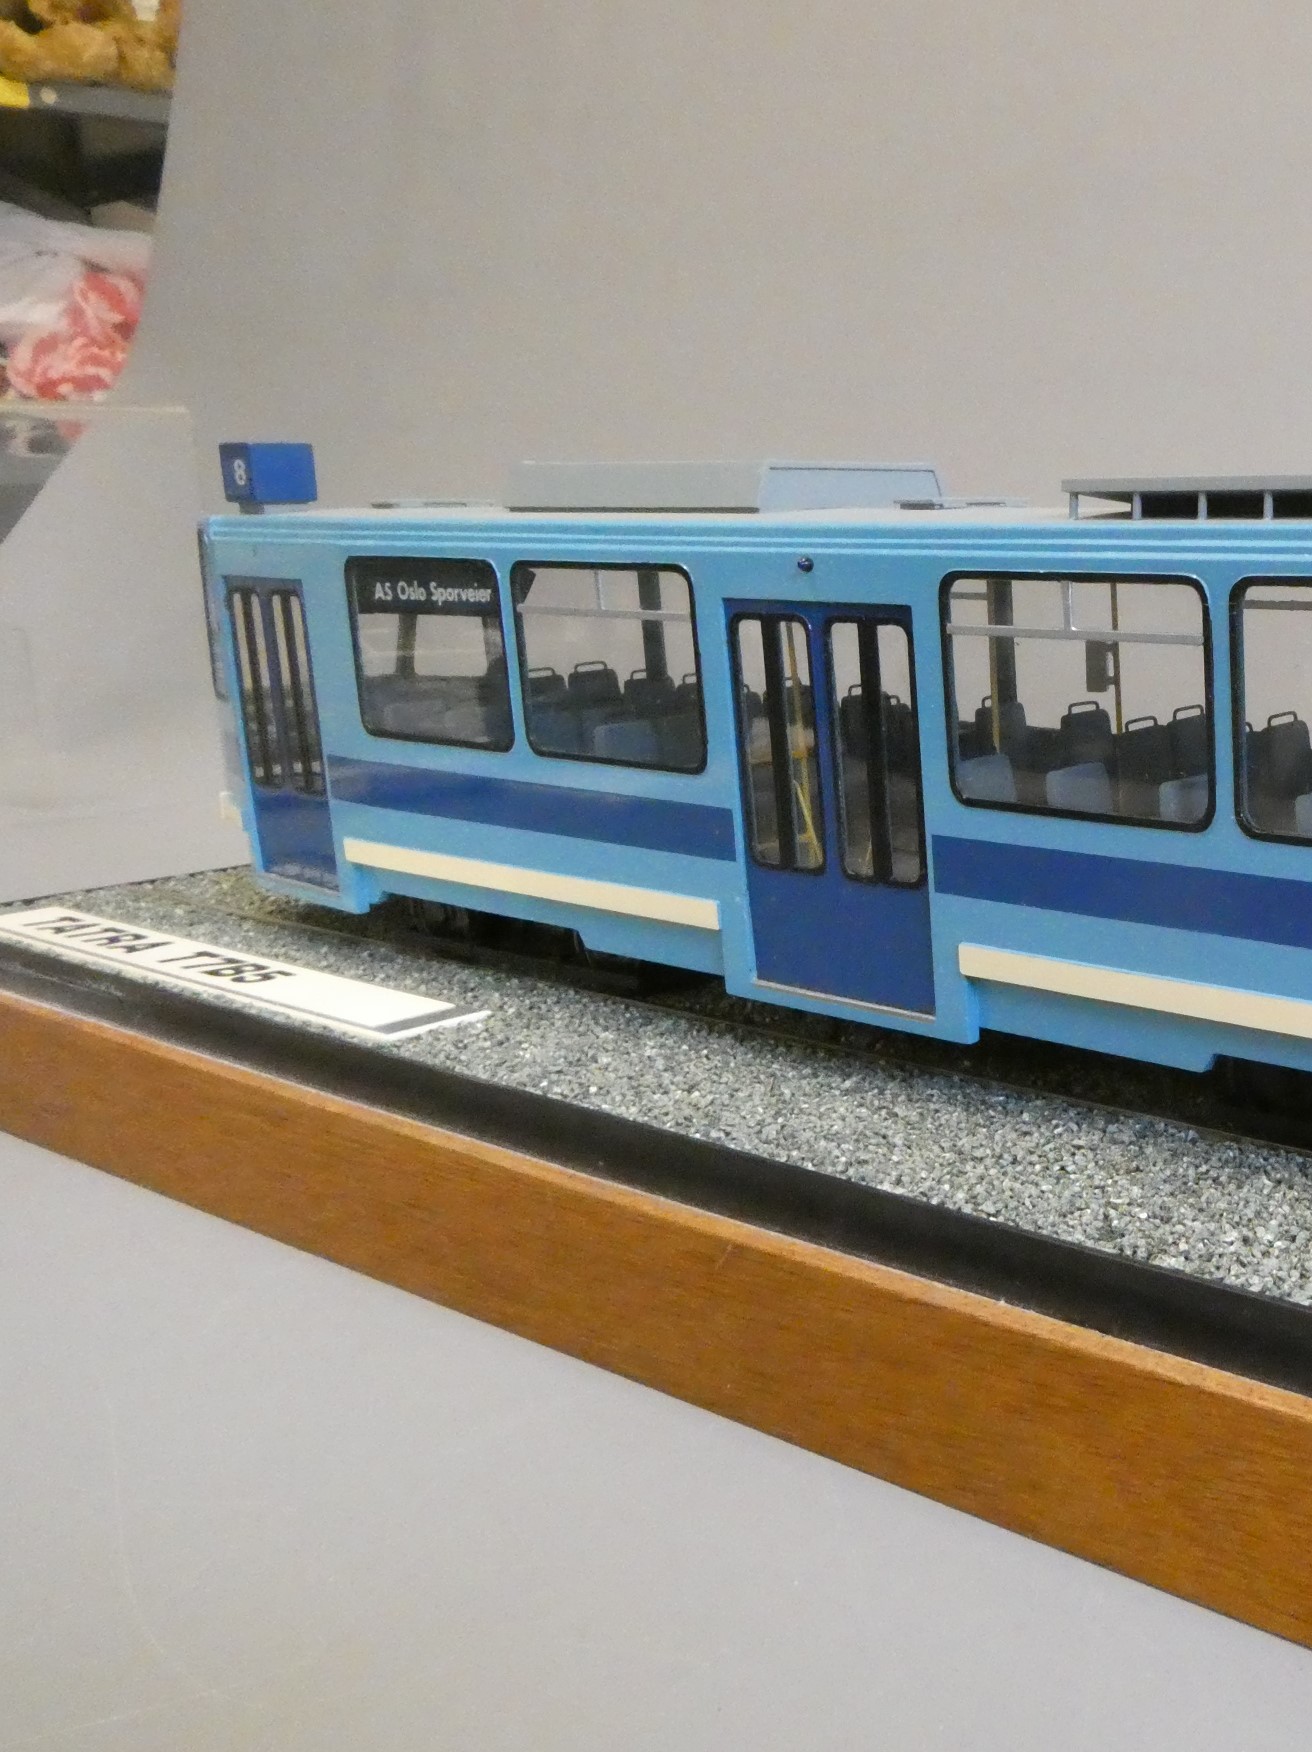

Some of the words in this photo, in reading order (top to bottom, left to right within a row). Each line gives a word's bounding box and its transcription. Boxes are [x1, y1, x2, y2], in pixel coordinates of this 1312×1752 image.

[233, 459, 246, 486] 8
[374, 581, 393, 600] AS
[397, 580, 427, 601] Oslo
[429, 581, 492, 606] Sporveier
[23, 916, 174, 954] TATRA
